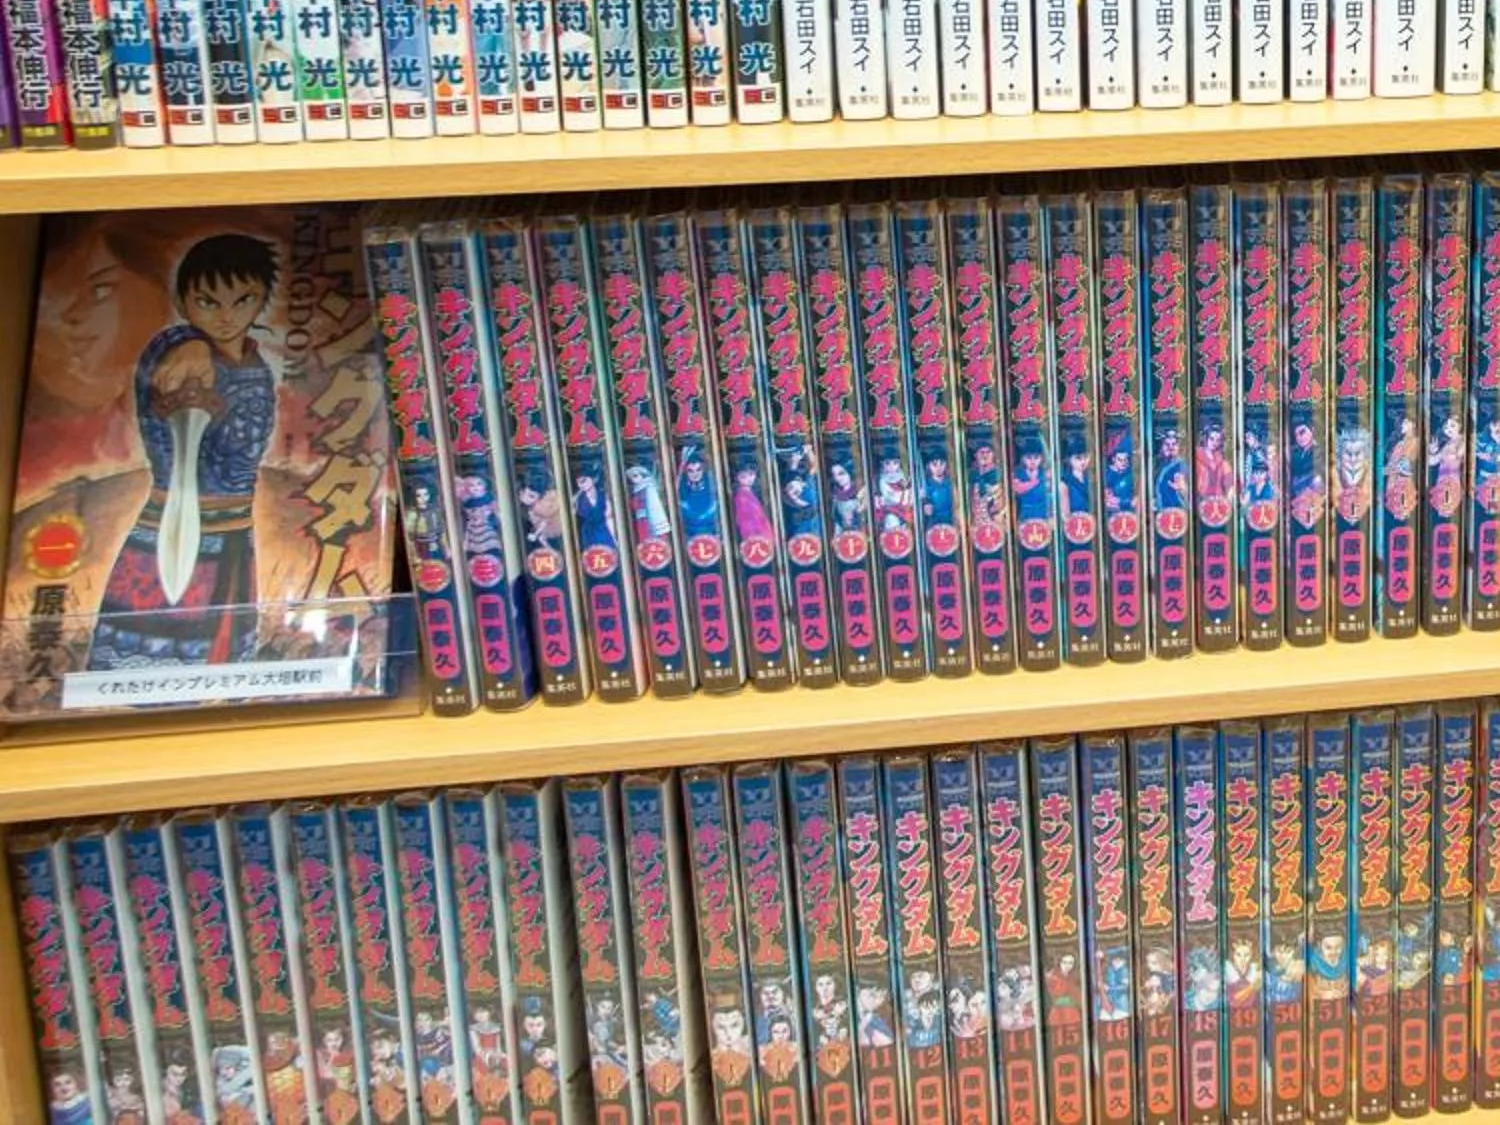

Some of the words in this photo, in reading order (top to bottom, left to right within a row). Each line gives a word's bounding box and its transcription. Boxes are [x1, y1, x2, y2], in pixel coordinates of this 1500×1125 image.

[304, 57, 338, 88] 光
[739, 50, 774, 74] 光
[381, 292, 436, 459] キングダム
[497, 281, 546, 449] キングダム
[605, 275, 656, 441] キングダム
[811, 269, 856, 434] キングダム
[1102, 254, 1139, 417] キングダム
[533, 554, 556, 572] 四
[644, 541, 667, 564] 六
[693, 539, 716, 561] 七
[746, 540, 768, 561] 八
[98, 671, 322, 695] くれたけインプレミアム大垣駅前
[846, 812, 887, 957] キングダム
[1226, 777, 1258, 919] キングダム
[1316, 771, 1346, 913] キングダム
